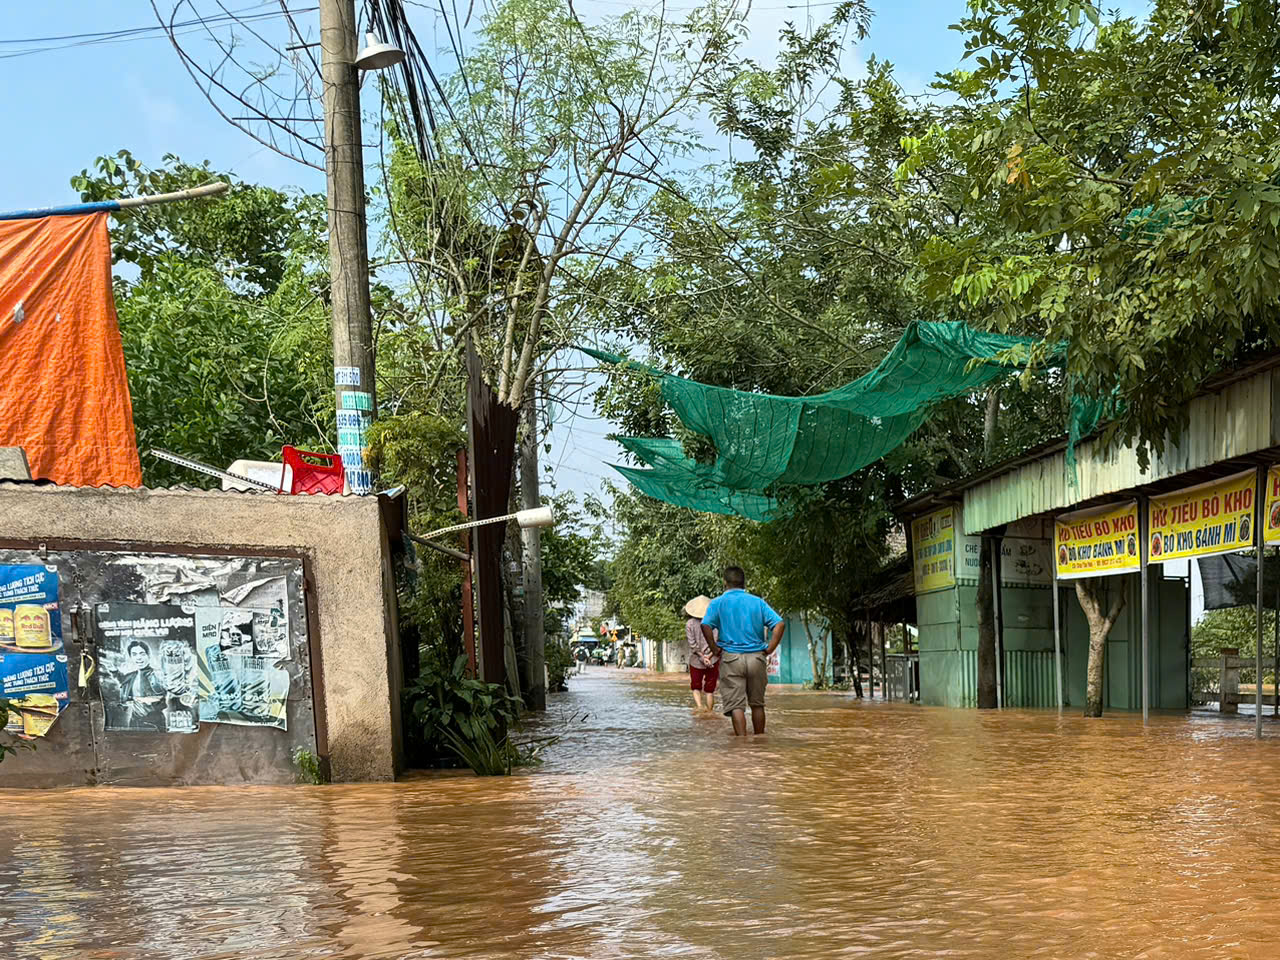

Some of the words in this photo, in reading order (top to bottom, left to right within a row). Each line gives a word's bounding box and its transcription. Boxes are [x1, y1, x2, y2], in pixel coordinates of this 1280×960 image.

[1202, 491, 1220, 519] BÒ
[1224, 488, 1252, 514] KHO
[1094, 516, 1110, 536] BÒ
[1112, 514, 1135, 534] KHO
[1164, 529, 1174, 553] BÒ
[1177, 530, 1193, 551] KHO
[1196, 523, 1222, 548] BÁNH
[1224, 517, 1237, 543] MÌ
